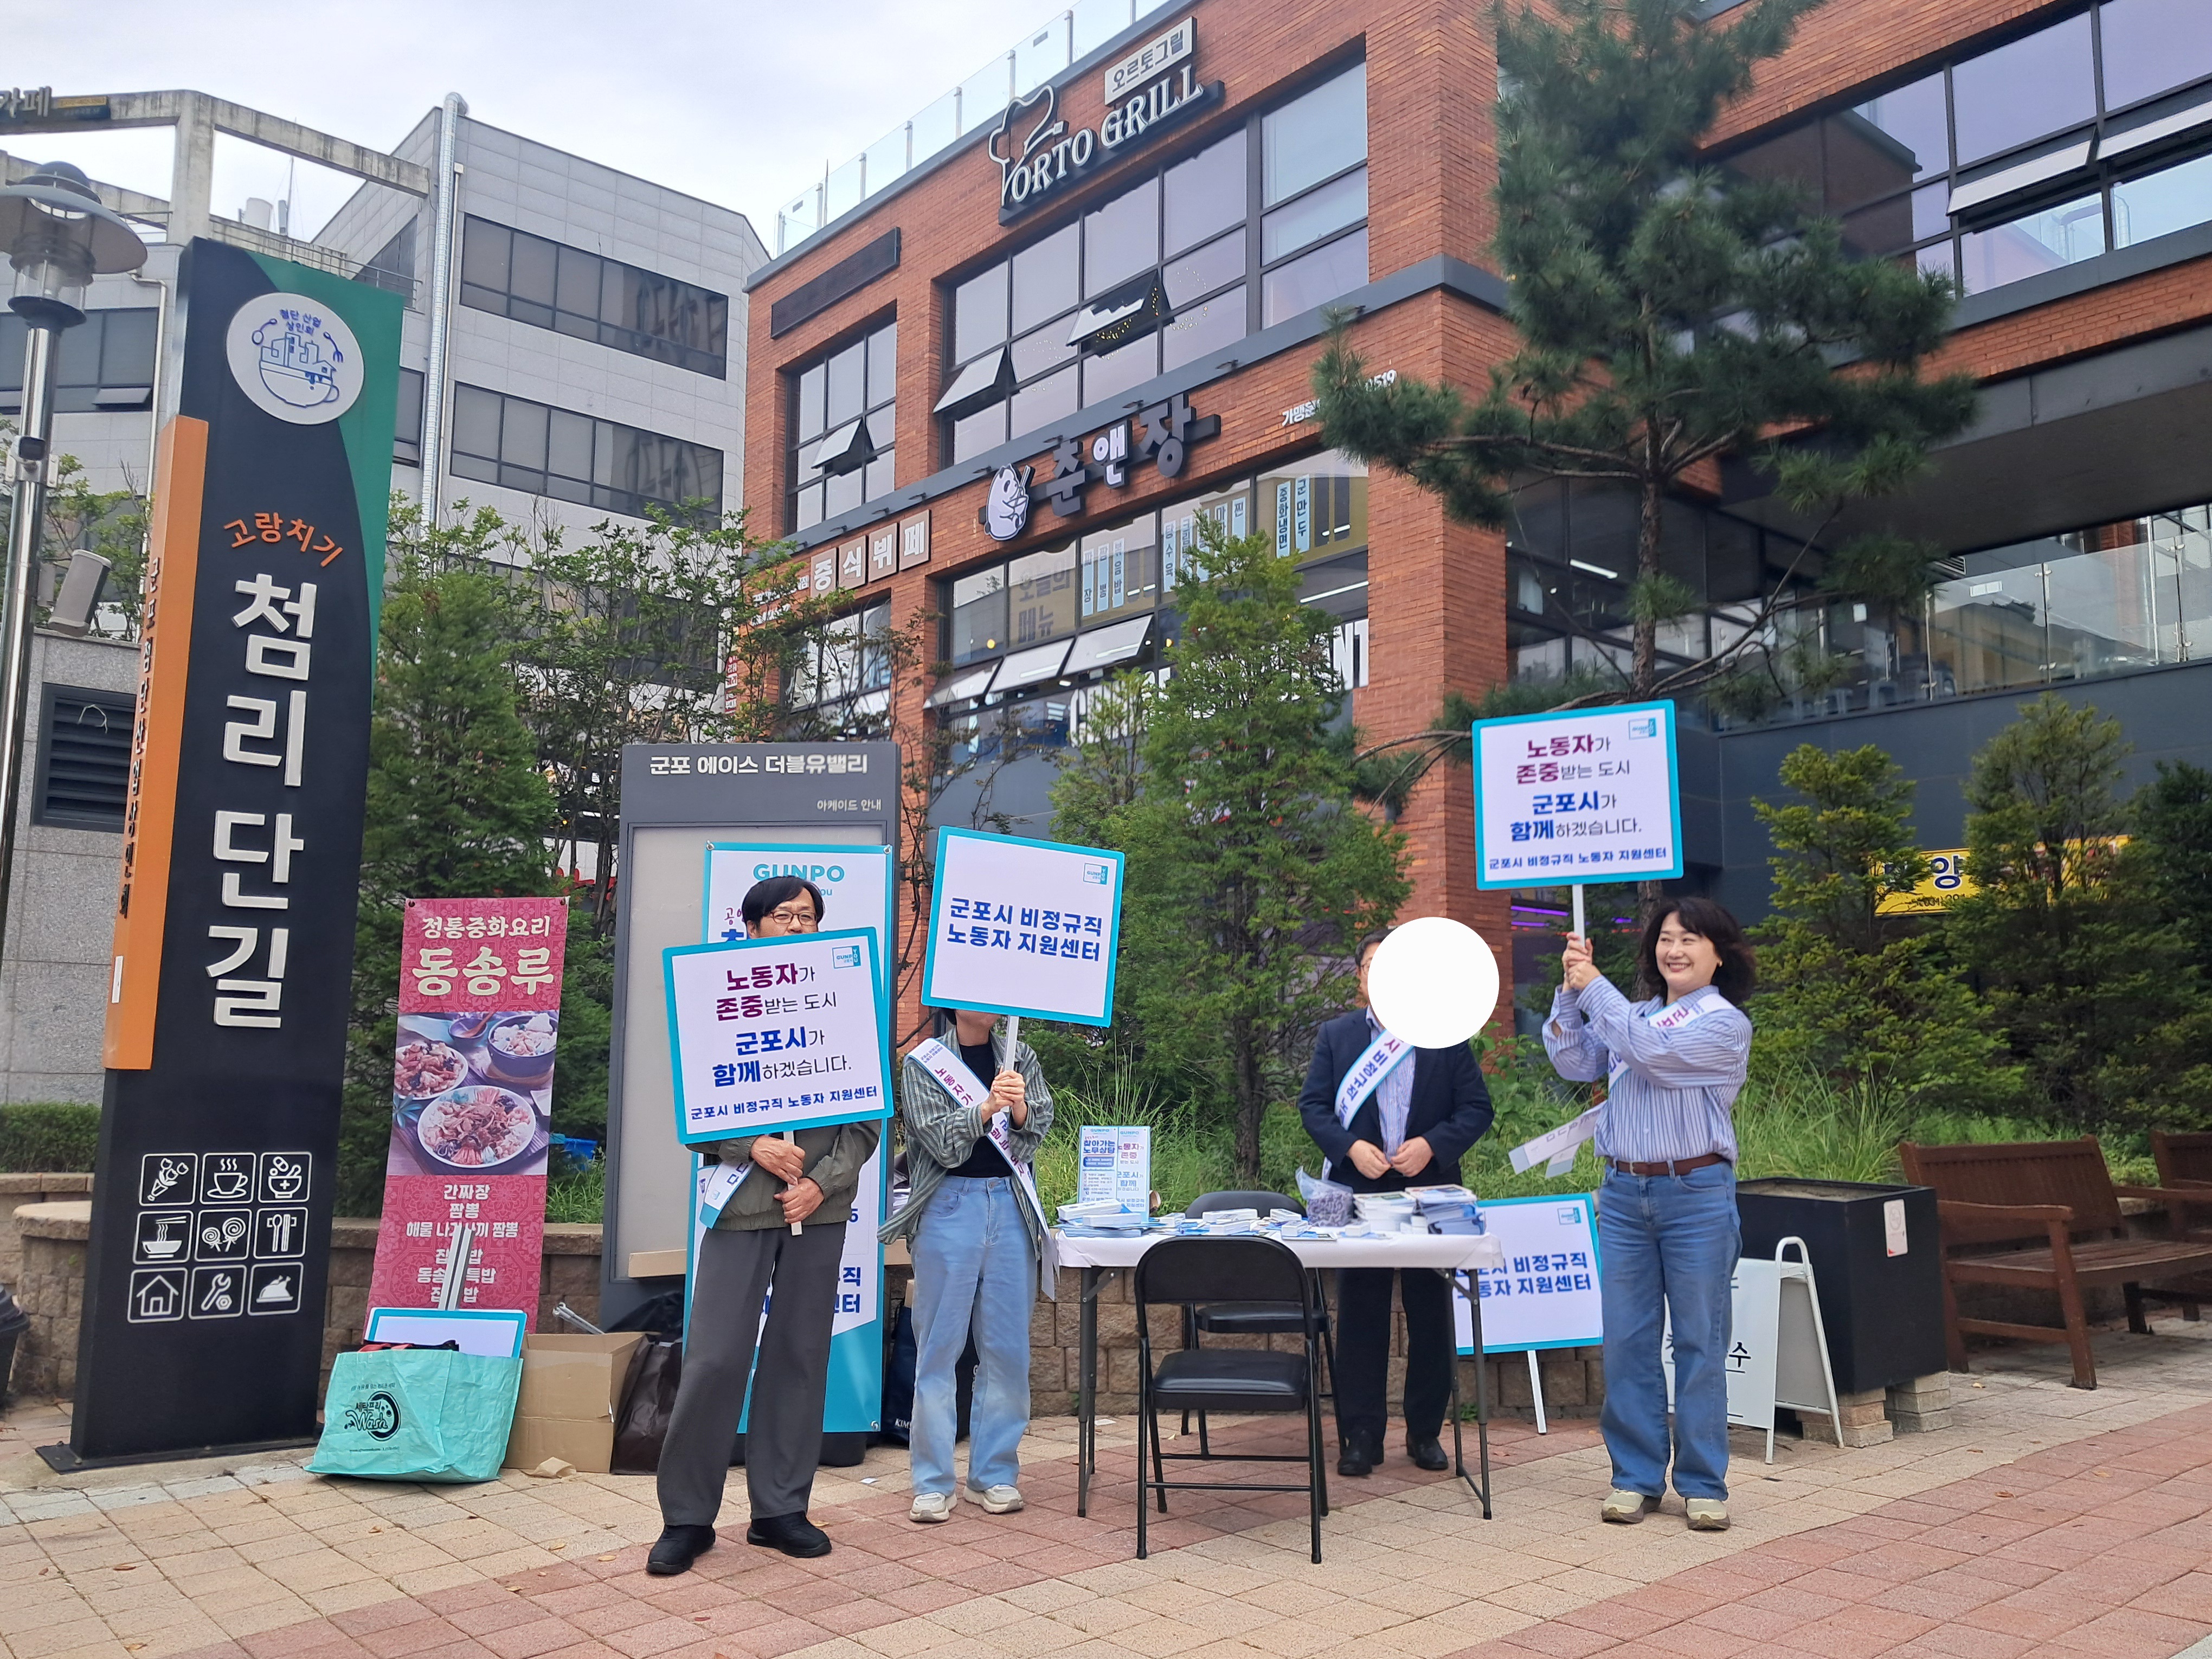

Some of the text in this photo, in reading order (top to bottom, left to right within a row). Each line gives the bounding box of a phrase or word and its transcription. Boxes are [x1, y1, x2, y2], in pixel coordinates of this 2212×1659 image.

[1111, 29, 1184, 93] 오르토그릴
[1011, 63, 1204, 203] ORTO GRILL
[1282, 398, 1321, 427] 가맹문
[1278, 487, 1289, 550] 중화냉면
[1296, 478, 1308, 537] 군만두
[223, 512, 344, 567] 고랑치기
[813, 520, 925, 591] 중식뷔페
[1527, 733, 1611, 759] 노동자가
[650, 753, 867, 775] 군포 에이스 더블유밸리
[1516, 759, 1630, 785] 존중받는 도시
[205, 573, 318, 1029] 첨리단길
[816, 799, 882, 812] 아케이드 안내
[1532, 790, 1617, 815] 군포시가
[1510, 817, 1642, 843] 함께하겠습니다.
[1489, 846, 1666, 870] 군포시 비정규직 노동자 지원센터
[753, 864, 845, 882] GUNPO
[421, 915, 551, 939] 정통중화요리
[950, 897, 1102, 937] 군포시 비정규직
[947, 923, 1100, 962] 노동자 지원센터
[411, 946, 554, 996] 동송루
[726, 963, 815, 991] 노동자가
[716, 992, 837, 1021] 존중받는 도시
[735, 1026, 825, 1056] 군포시가
[712, 1054, 852, 1087] 함께하겠습니다.
[1346, 1049, 1388, 1102] 비정규직
[934, 1068, 974, 1106] 노동자가
[690, 1085, 878, 1121] 군포시 비정규직 노동자 지원센터
[443, 1184, 490, 1200] 간짜장
[449, 1203, 480, 1219] 짬뽕
[407, 1221, 433, 1238] 해물
[492, 1221, 518, 1238] 짬뽕
[417, 1267, 497, 1284] 동송특밥
[1513, 1252, 1588, 1273] 비정규직
[1516, 1272, 1591, 1294] 지원센터
[345, 1410, 388, 1431] Wash
[355, 1401, 382, 1413] 세탁프리
